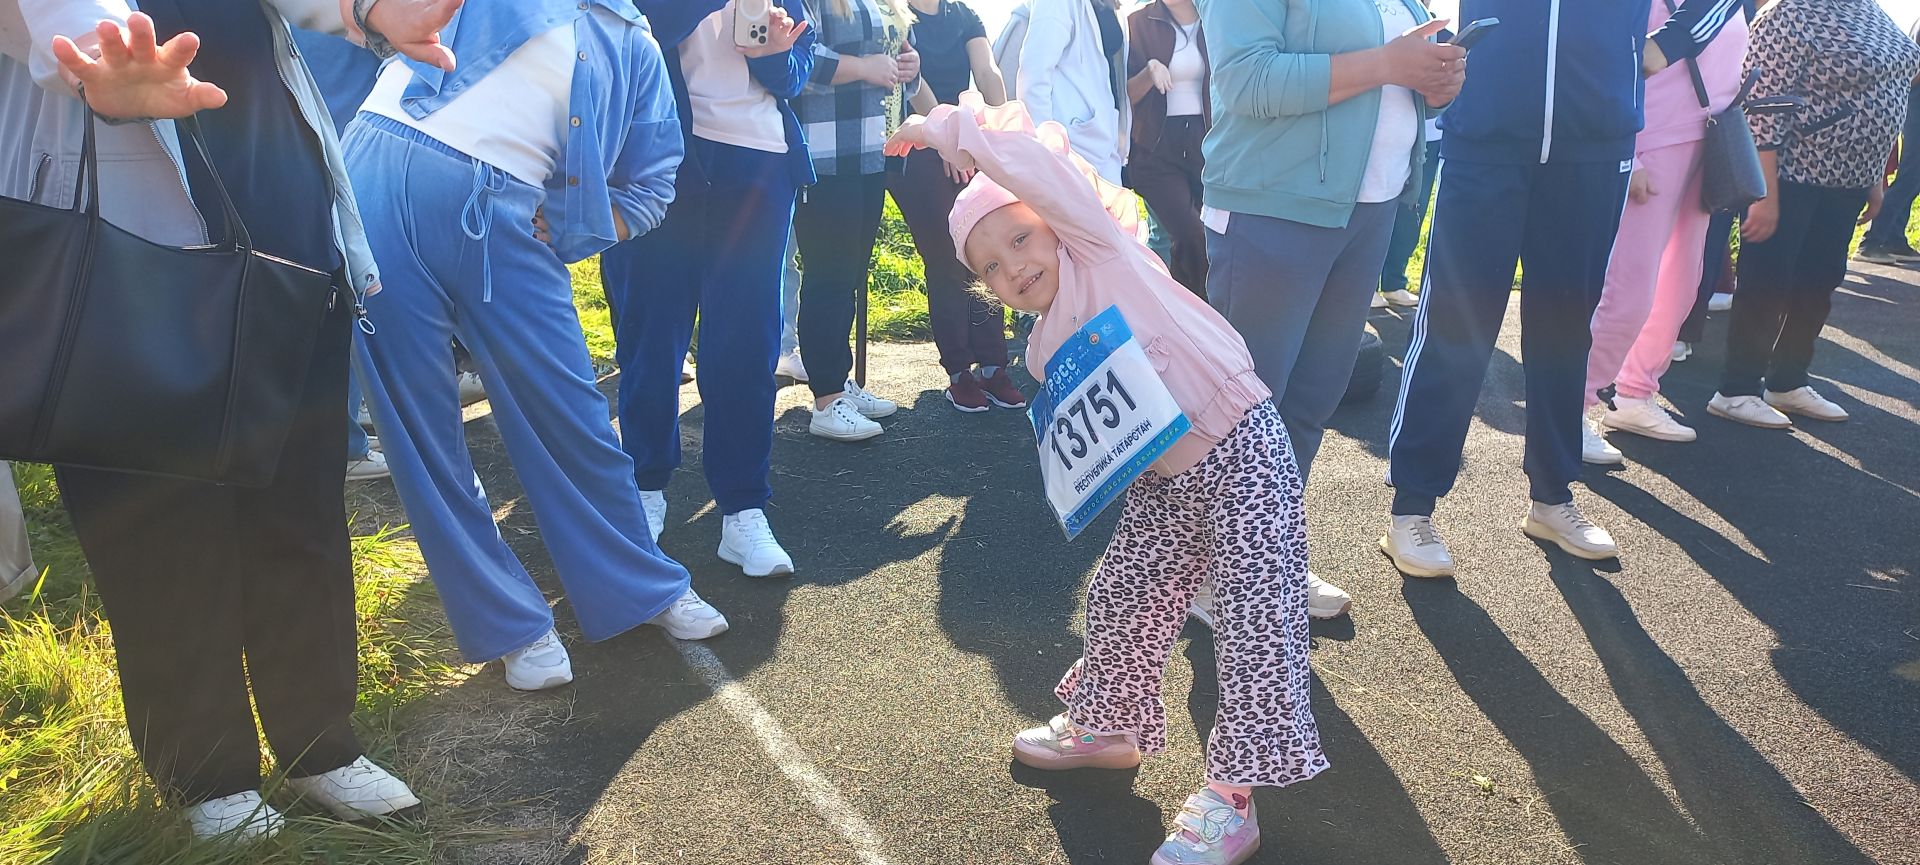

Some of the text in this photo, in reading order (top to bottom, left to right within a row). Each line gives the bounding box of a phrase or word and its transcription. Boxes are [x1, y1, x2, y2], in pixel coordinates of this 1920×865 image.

[1046, 357, 1077, 394] РОСС
[1051, 369, 1137, 471] 13751
[1074, 421, 1153, 495] РЕСПУБЛИКА ТАТАРСТАН
